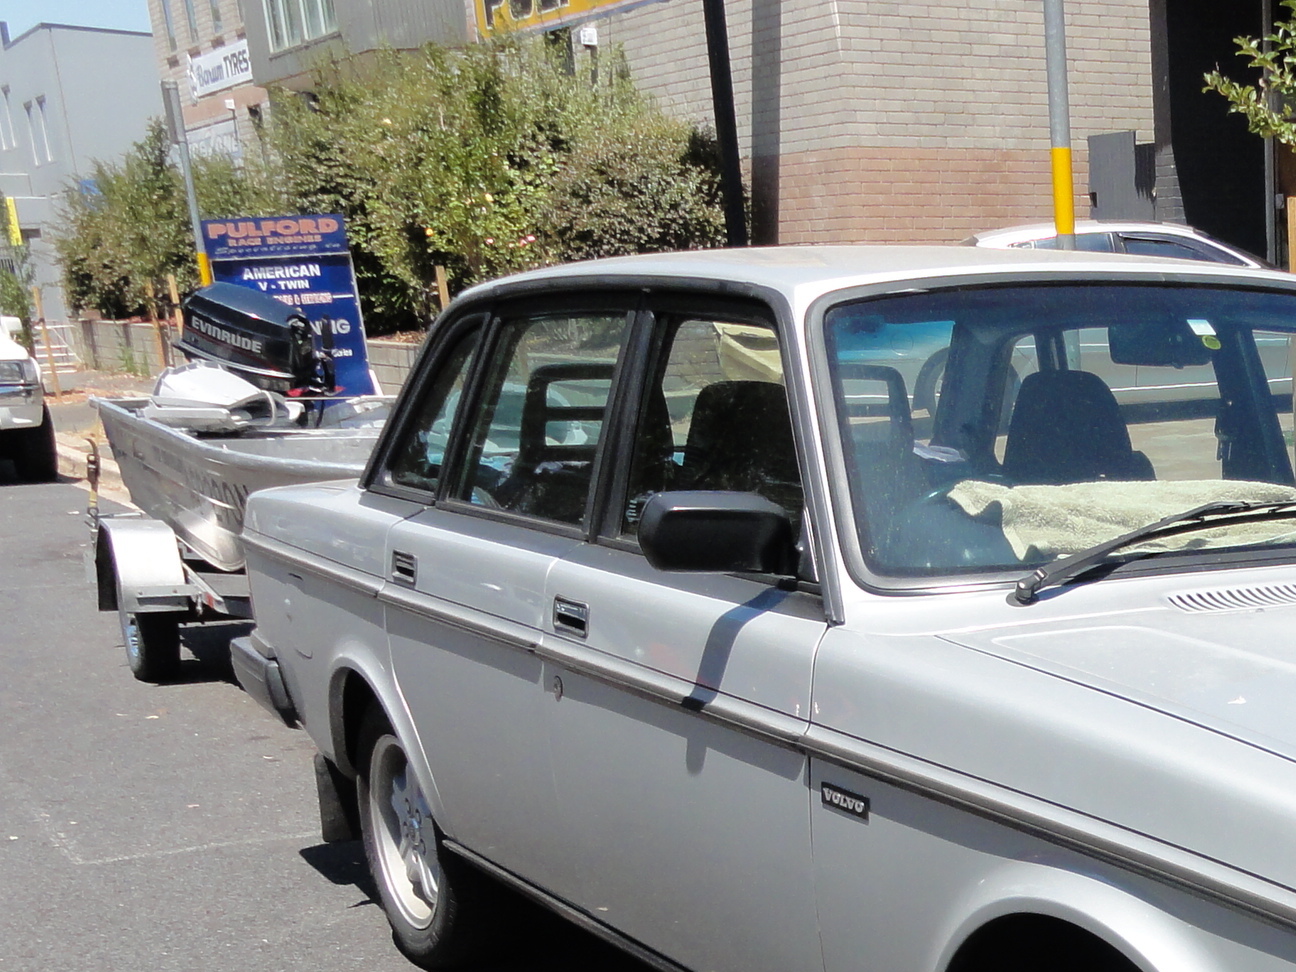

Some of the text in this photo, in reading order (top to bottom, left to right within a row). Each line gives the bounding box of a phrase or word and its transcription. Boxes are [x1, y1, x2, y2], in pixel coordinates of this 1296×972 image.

[223, 49, 250, 78] TYRES
[207, 218, 339, 239] PULFORD
[227, 237, 262, 247] RACE
[243, 264, 322, 280] AMERICAN
[257, 281, 268, 291] V
[278, 280, 310, 290] TWIN
[191, 315, 263, 354] EVINRUDE
[823, 787, 865, 813] VOLVO
